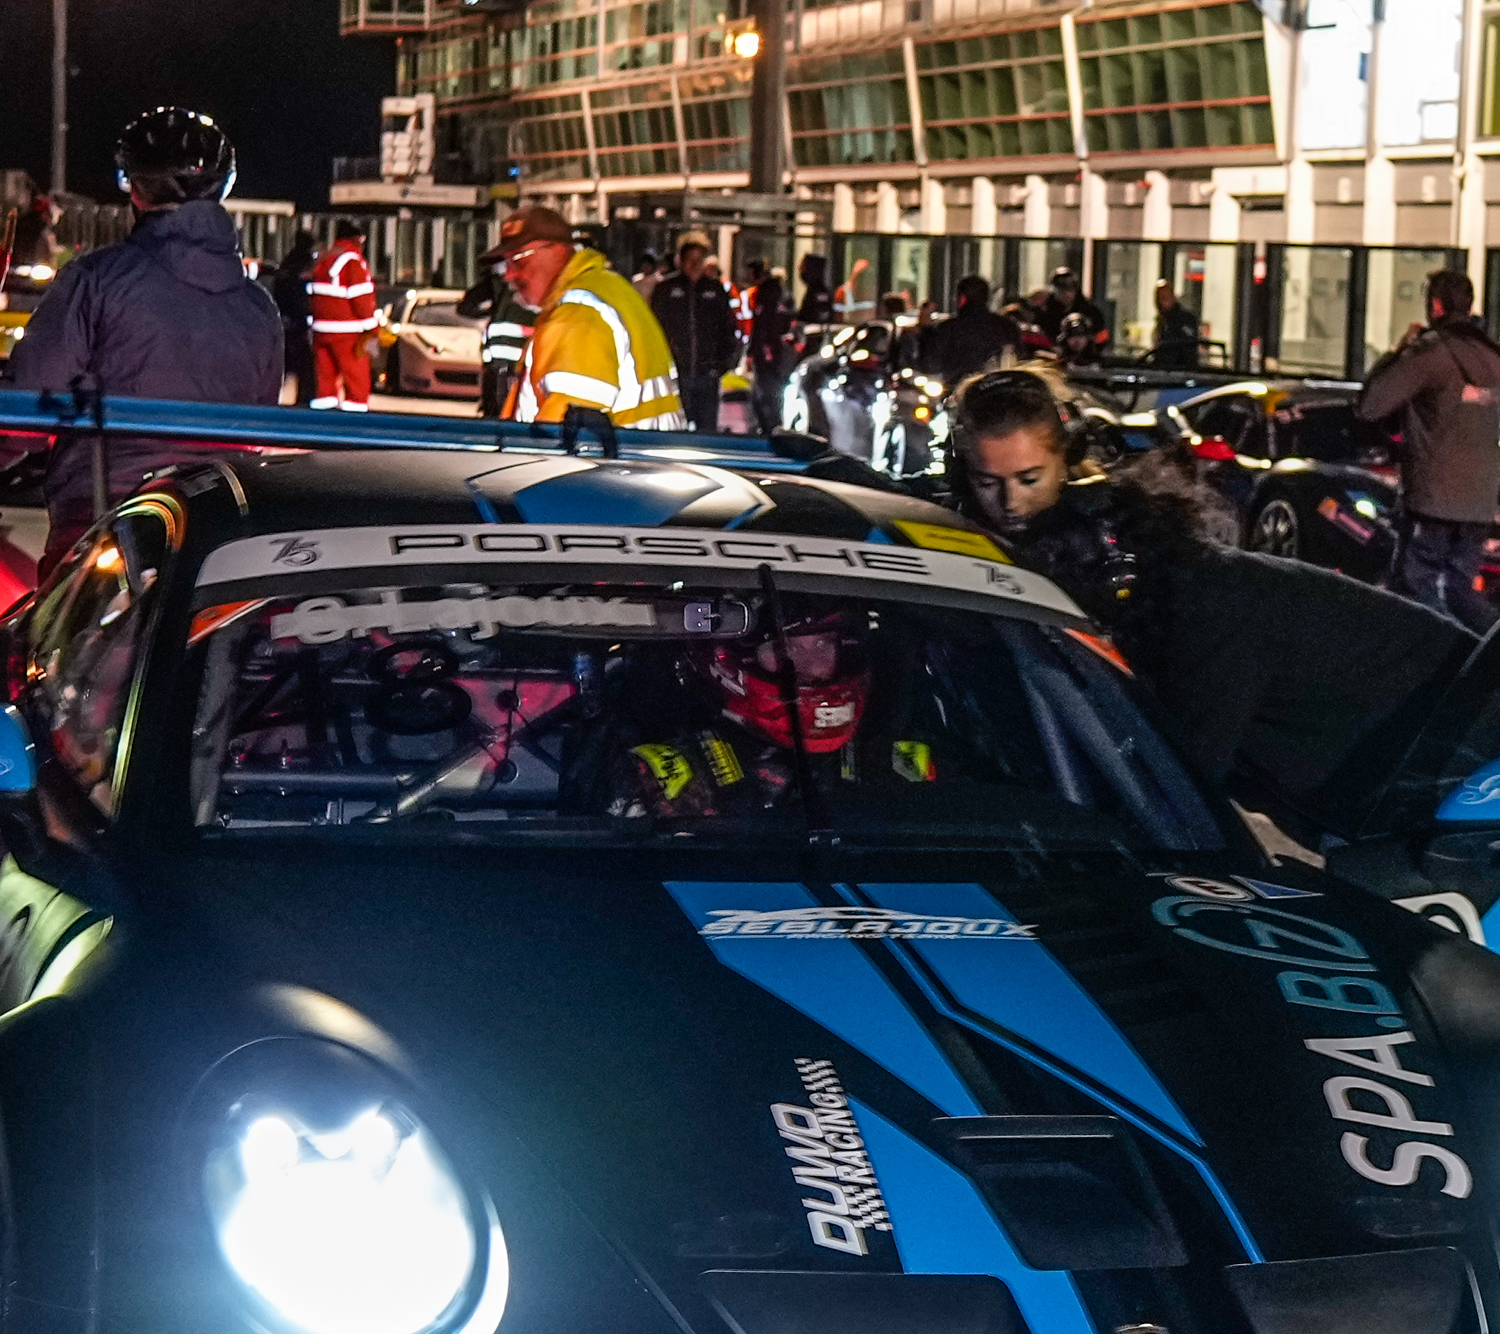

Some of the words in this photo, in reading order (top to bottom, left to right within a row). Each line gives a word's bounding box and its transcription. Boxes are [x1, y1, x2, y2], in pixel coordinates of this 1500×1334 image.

[389, 533, 933, 578] PORSCHE
[697, 919, 1039, 938] SEBLAJOUX
[809, 1092, 879, 1185] RACING
[769, 1102, 870, 1257] DUWO
